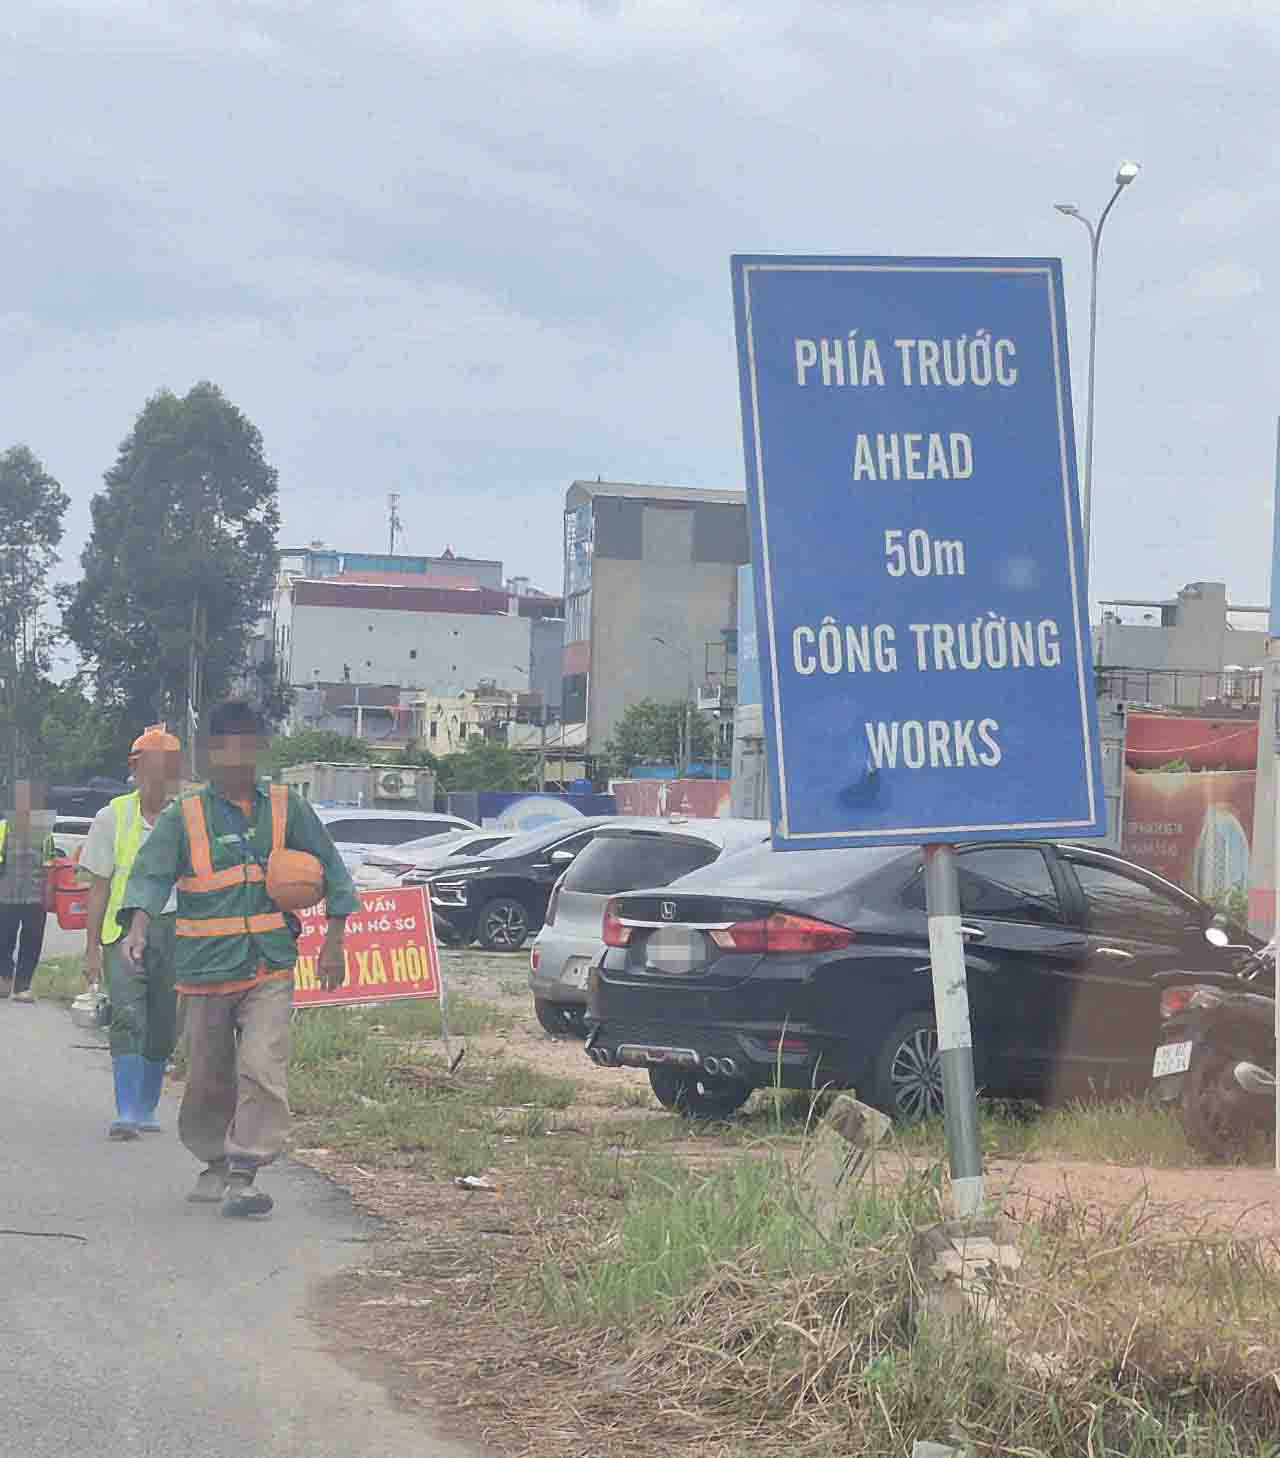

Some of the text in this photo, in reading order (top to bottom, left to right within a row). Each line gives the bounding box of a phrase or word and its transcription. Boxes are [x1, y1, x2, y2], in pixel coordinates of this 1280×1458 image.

[793, 329, 1017, 387] PHÍA TRƯỚC
[853, 432, 973, 481] AHEAD
[884, 528, 966, 577] 50m
[792, 612, 1062, 675] CÔNG TRƯỜNG
[865, 718, 1002, 769] WORKS
[391, 940, 430, 989] HỘI
